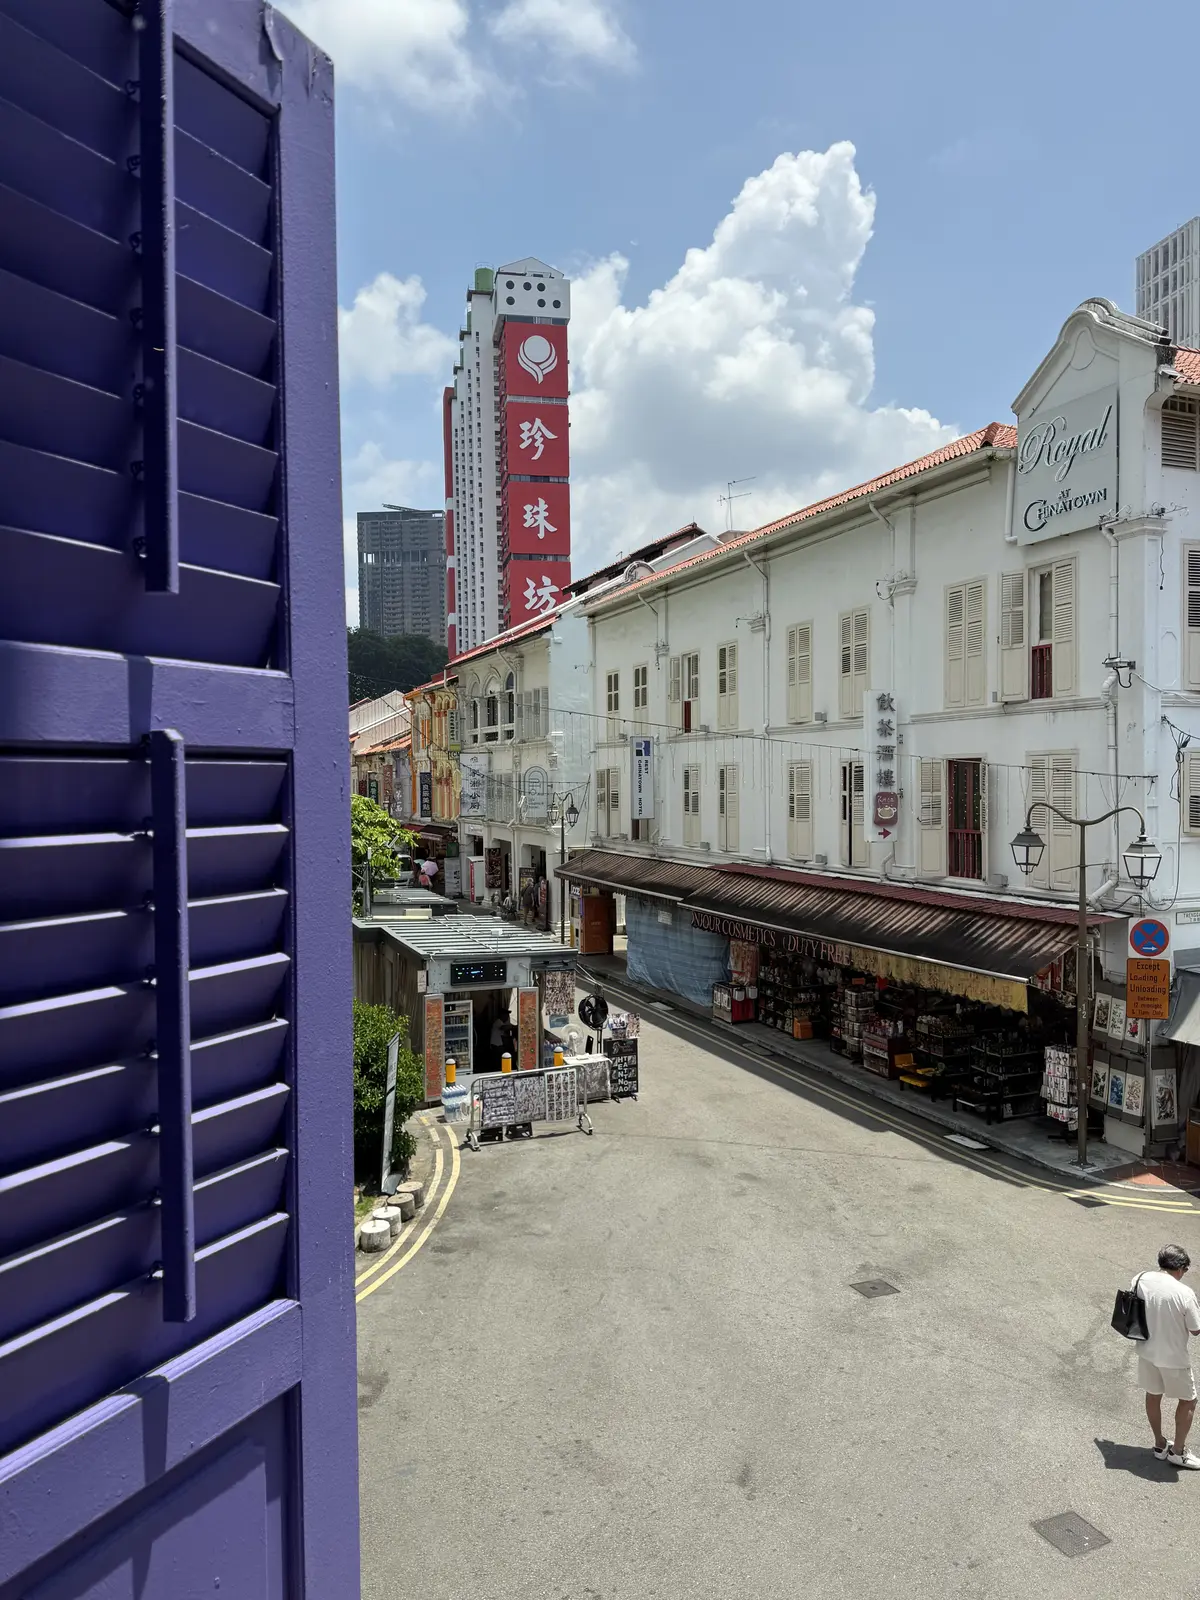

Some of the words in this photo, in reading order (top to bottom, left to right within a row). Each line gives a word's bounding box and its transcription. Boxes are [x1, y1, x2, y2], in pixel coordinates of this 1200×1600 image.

[1018, 404, 1113, 482] Royal
[1058, 488, 1071, 500] AT
[518, 418, 558, 614] 珍珠坊
[722, 919, 776, 947] COSMETICS
[820, 942, 851, 966] FREE
[1136, 962, 1160, 972] Except
[1130, 974, 1158, 983] Loading
[1130, 984, 1166, 995] Unloading
[1152, 1009, 1164, 1017] Only
